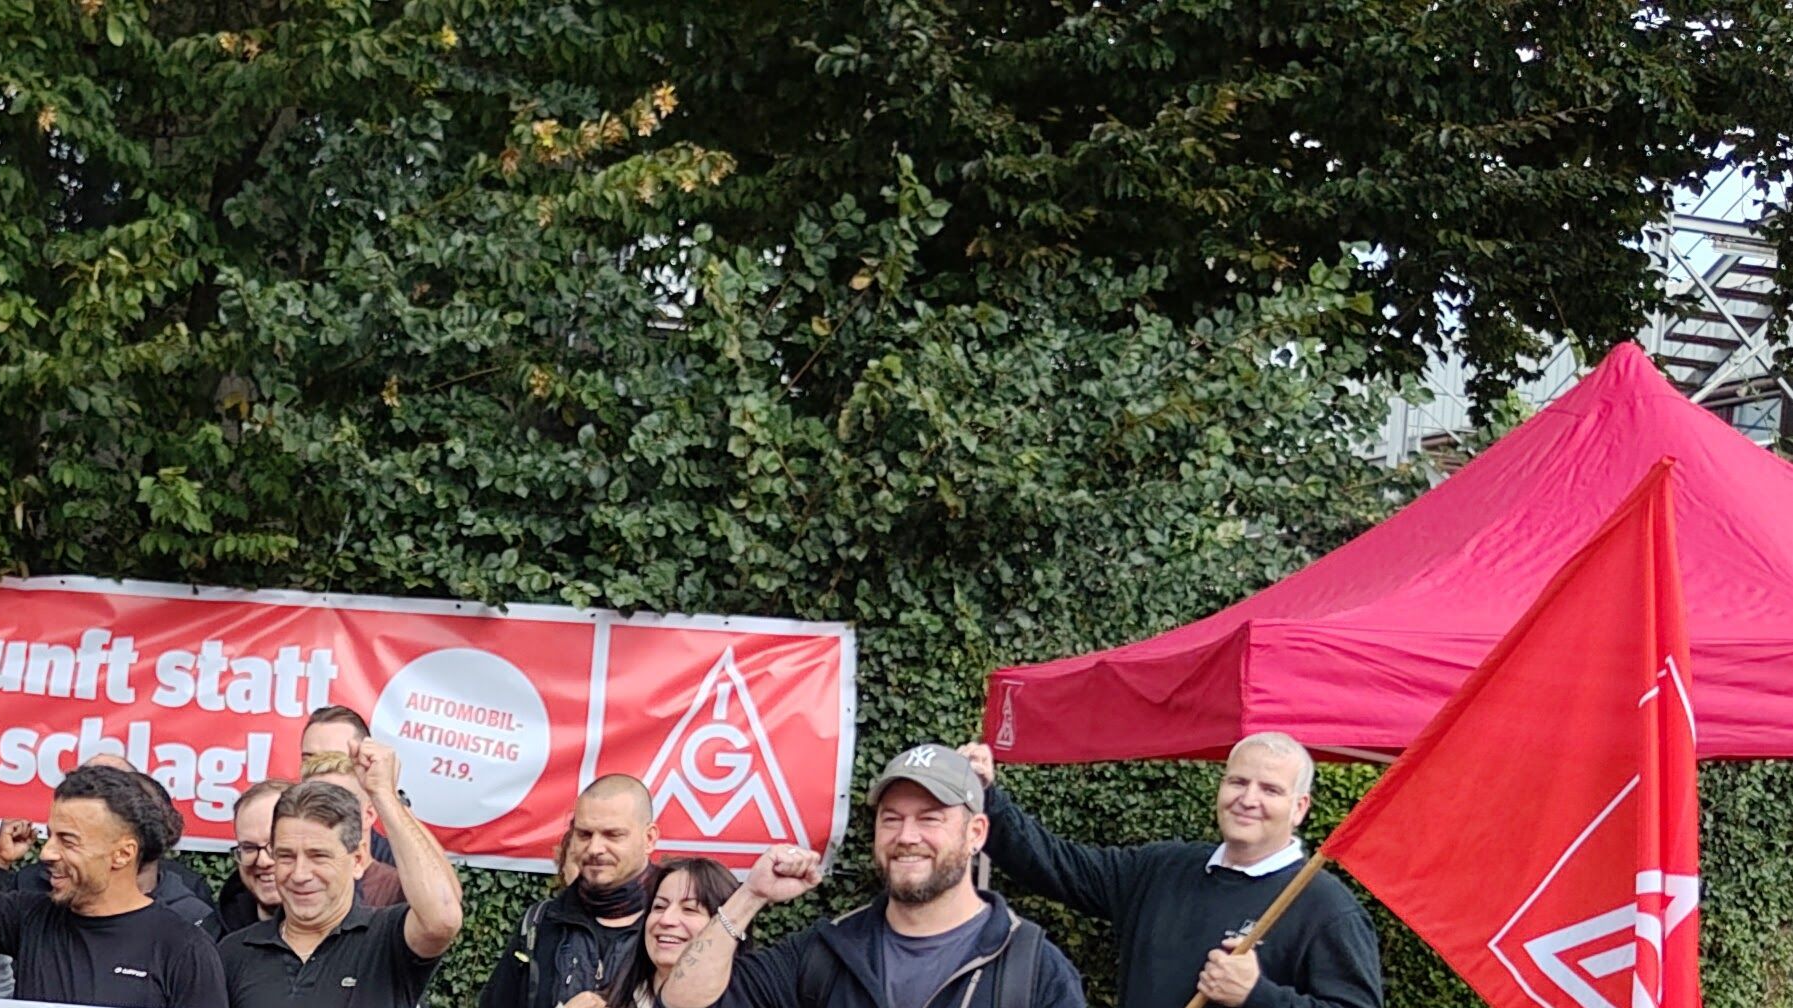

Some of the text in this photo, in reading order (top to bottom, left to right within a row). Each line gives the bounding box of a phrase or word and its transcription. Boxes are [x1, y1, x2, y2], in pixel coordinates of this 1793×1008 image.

[151, 639, 338, 717] statt
[405, 692, 523, 731] AUTOMOBIL-
[399, 720, 519, 761] AKTIONSTAG
[430, 757, 473, 782] 21.9.
